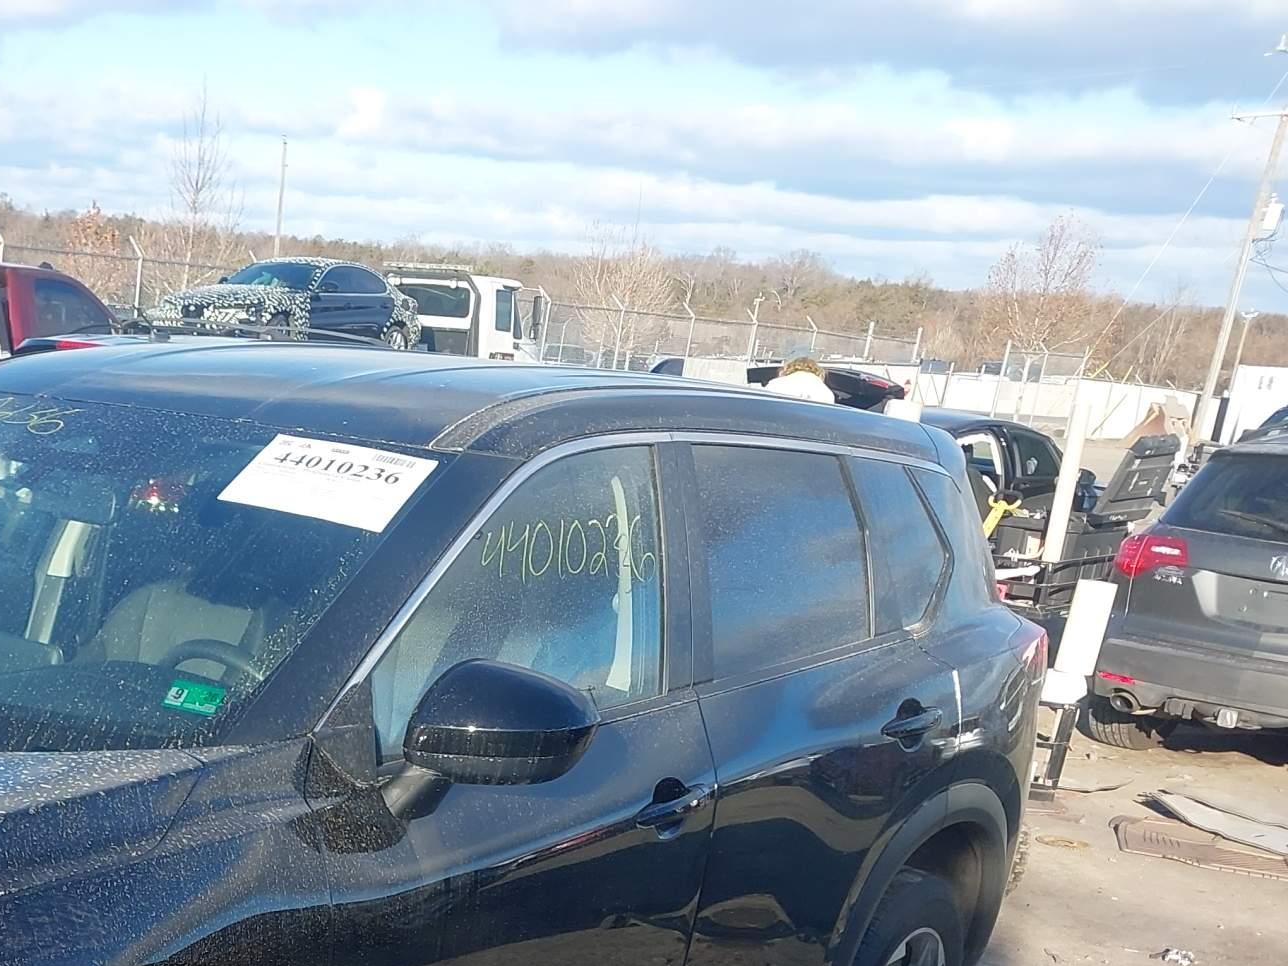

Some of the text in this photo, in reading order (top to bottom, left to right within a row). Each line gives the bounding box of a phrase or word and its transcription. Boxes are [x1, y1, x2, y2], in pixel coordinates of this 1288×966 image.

[273, 450, 402, 486] 44010236
[480, 513, 657, 585] 44010236
[170, 687, 186, 701] 9
